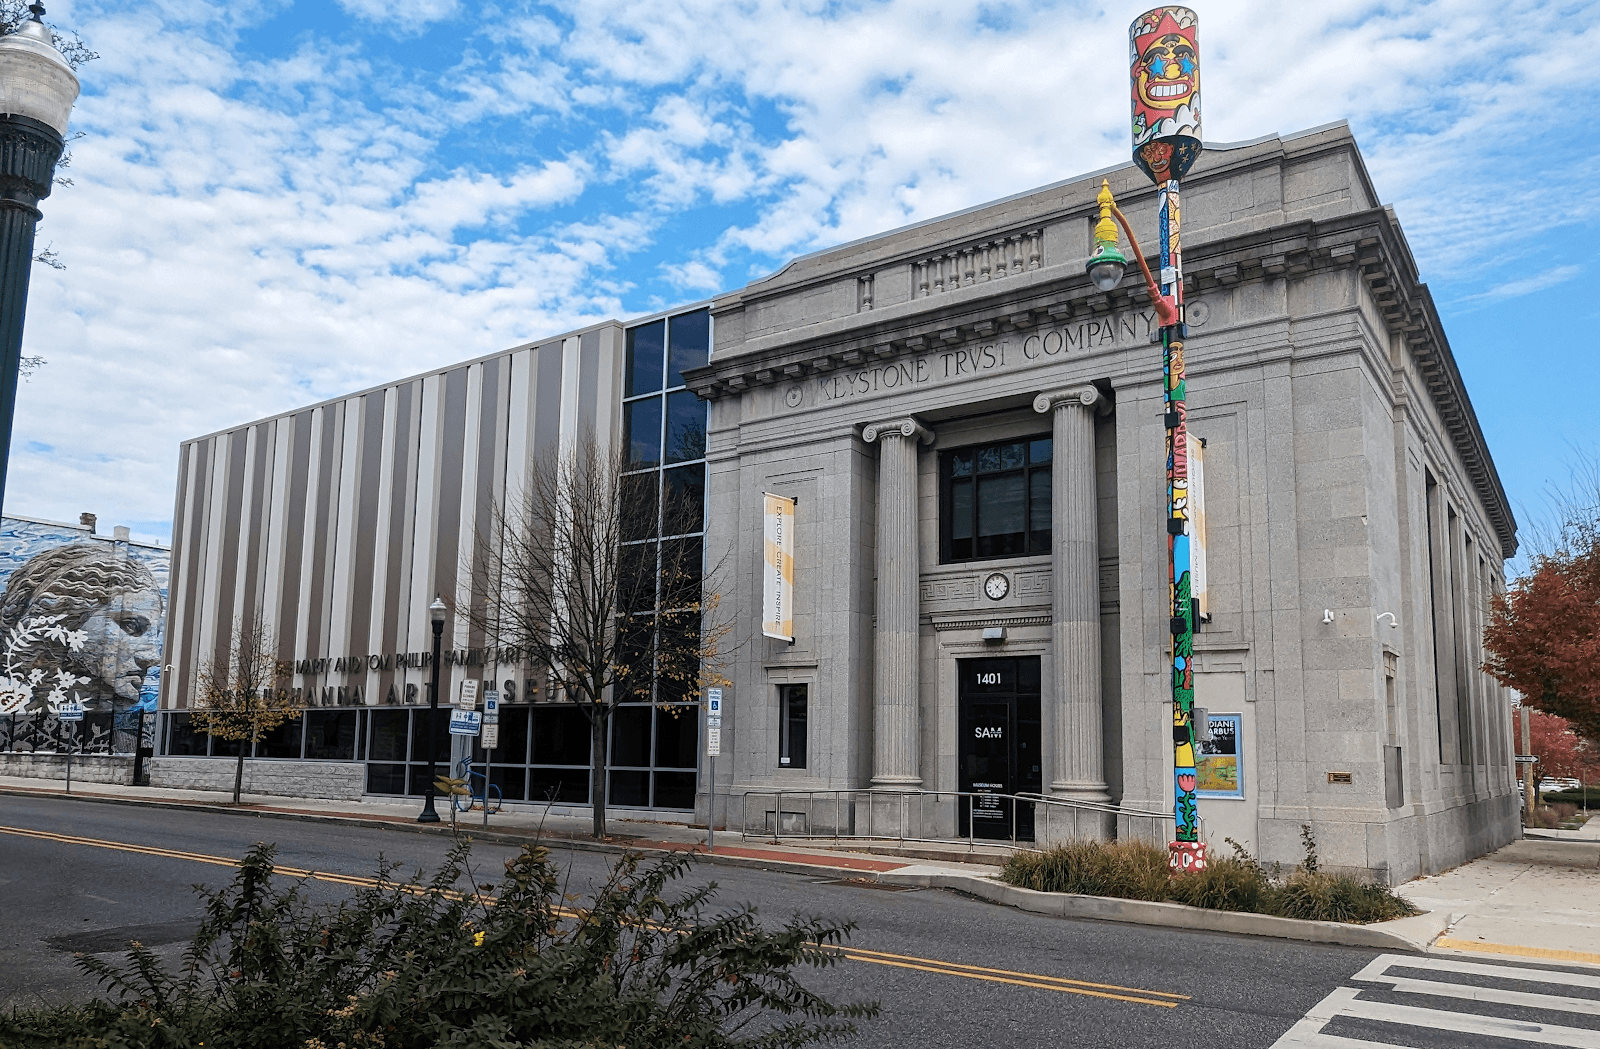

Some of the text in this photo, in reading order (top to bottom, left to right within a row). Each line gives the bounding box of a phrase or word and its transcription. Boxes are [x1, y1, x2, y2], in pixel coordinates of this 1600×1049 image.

[820, 359, 930, 400] KEYSTONE
[1023, 310, 1157, 360] COMPANY
[296, 658, 333, 675] MARTY
[334, 655, 363, 674] AND
[365, 653, 392, 671] TOM
[396, 651, 434, 669] PHILIP
[976, 672, 1002, 685] 1401
[1208, 720, 1235, 728] DIANE
[975, 727, 1002, 738] SAM
[1208, 727, 1235, 735] ARBUS
